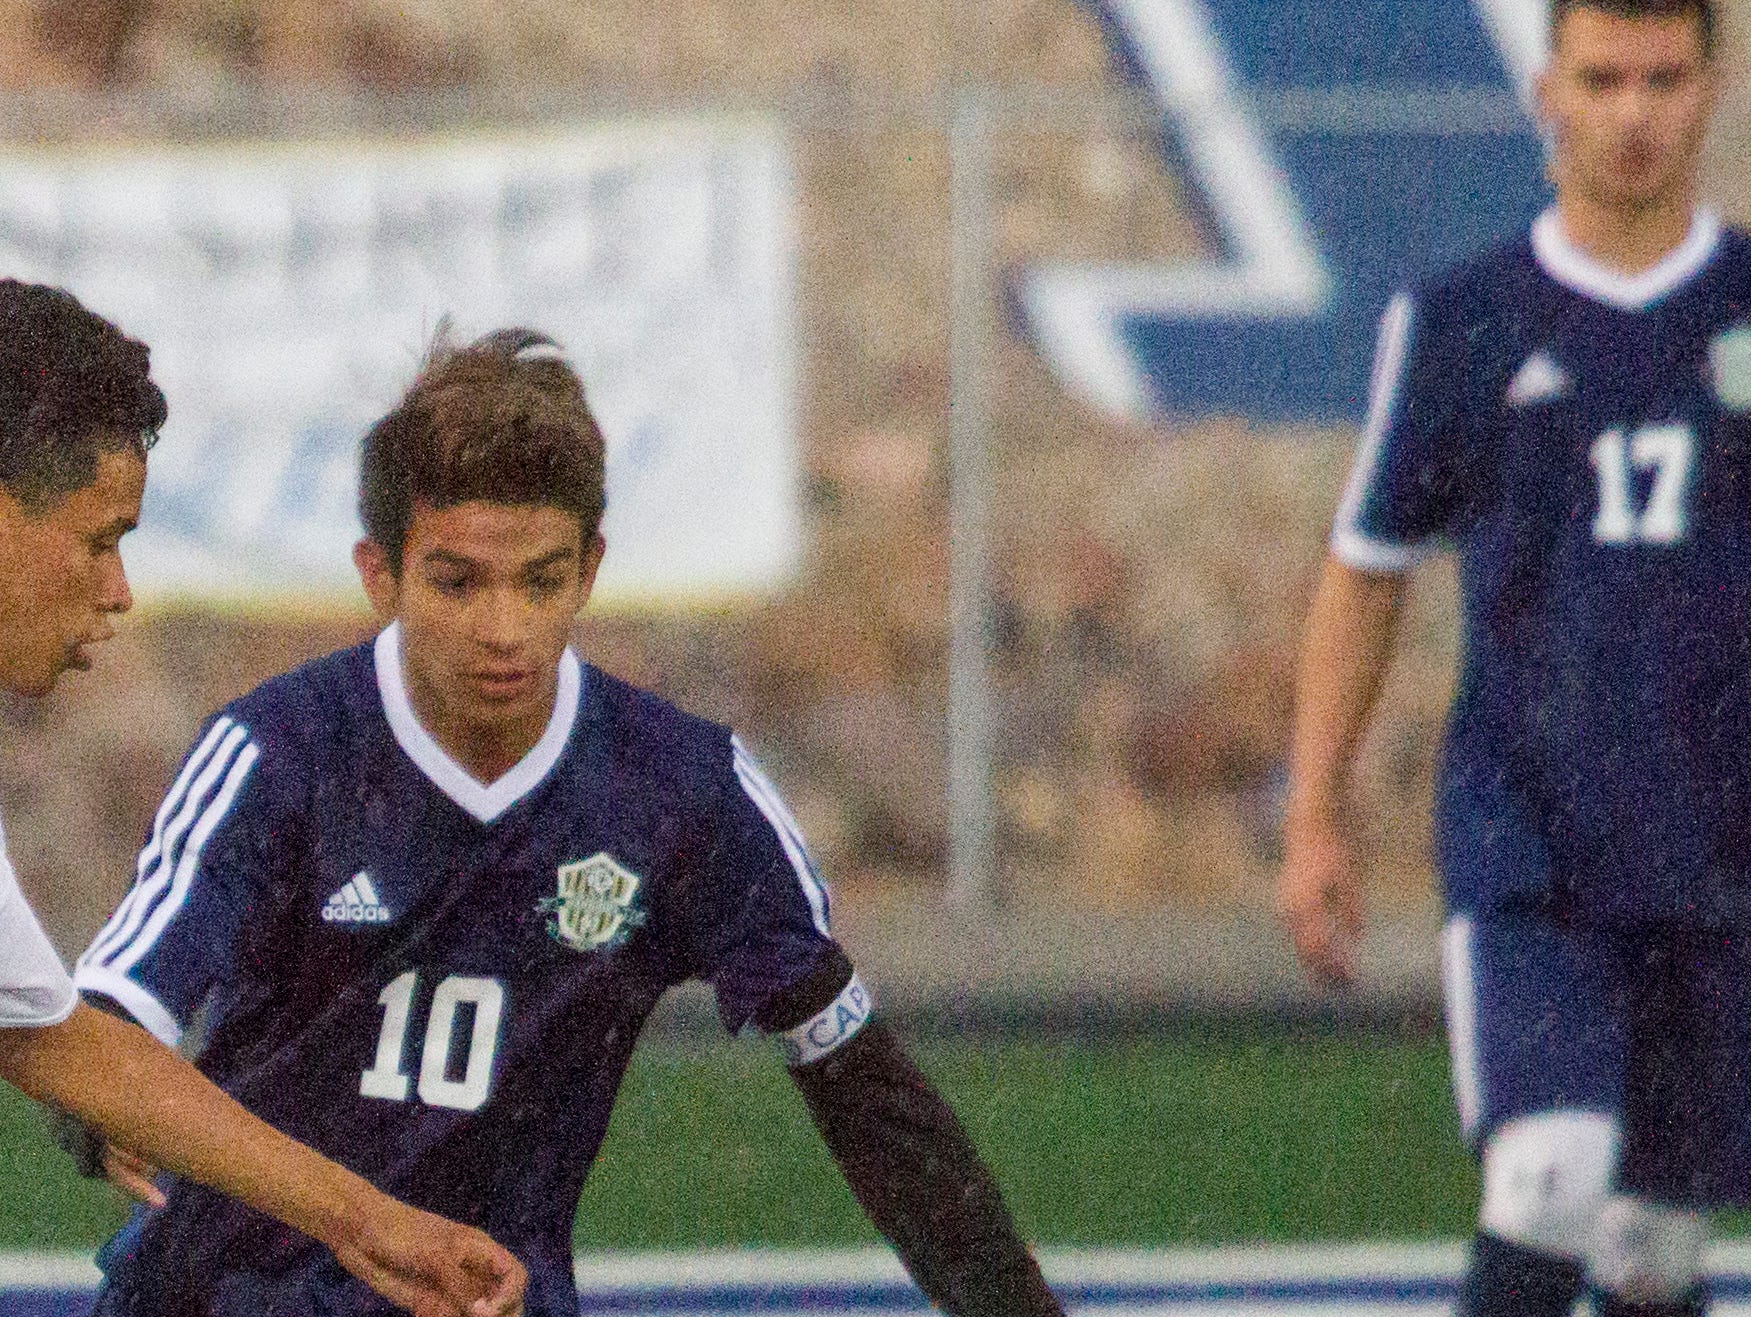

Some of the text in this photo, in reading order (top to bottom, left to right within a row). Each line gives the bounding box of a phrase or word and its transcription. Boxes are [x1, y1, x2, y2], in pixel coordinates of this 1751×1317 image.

[1591, 421, 1696, 546] 17
[321, 901, 390, 922] adidas
[359, 969, 505, 1112] 10
